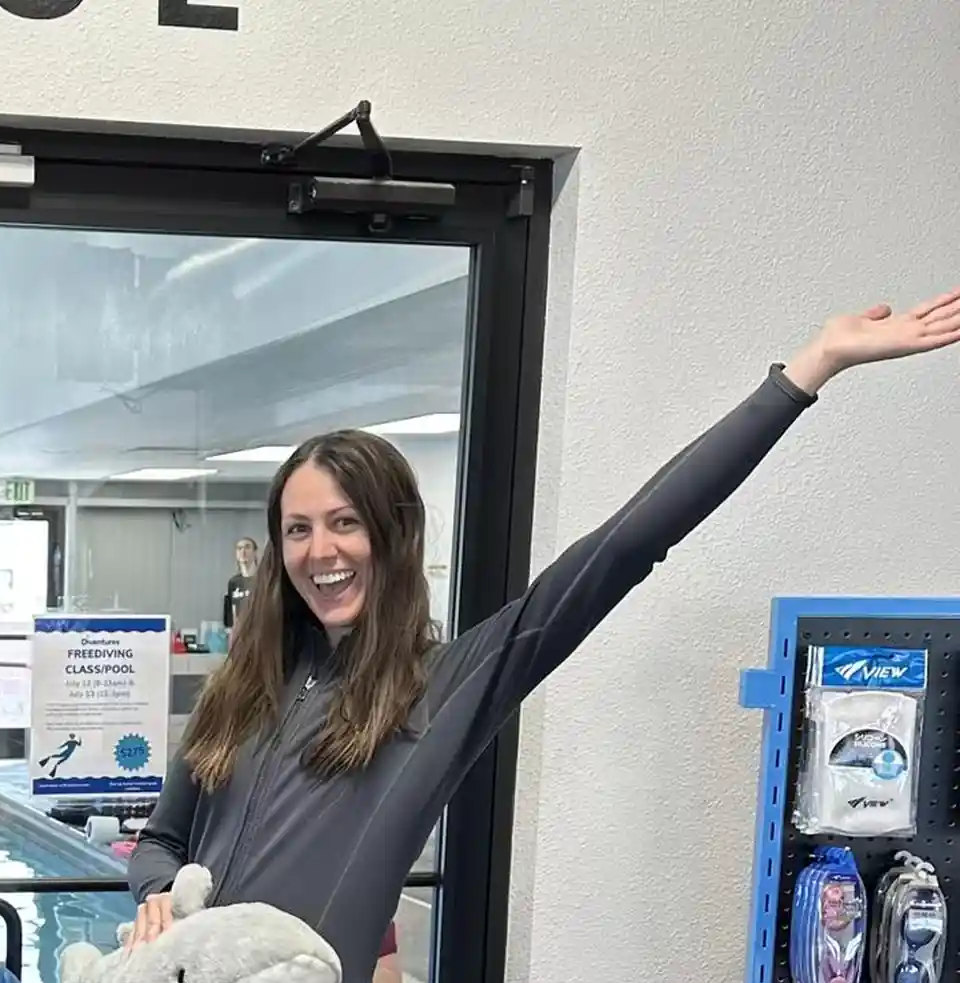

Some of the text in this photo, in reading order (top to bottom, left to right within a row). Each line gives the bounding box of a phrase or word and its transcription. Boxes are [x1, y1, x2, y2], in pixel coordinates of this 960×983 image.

[67, 649, 133, 659] FREEDIVING
[65, 664, 136, 674] CLASS/POOL
[862, 666, 908, 680] VIEW
